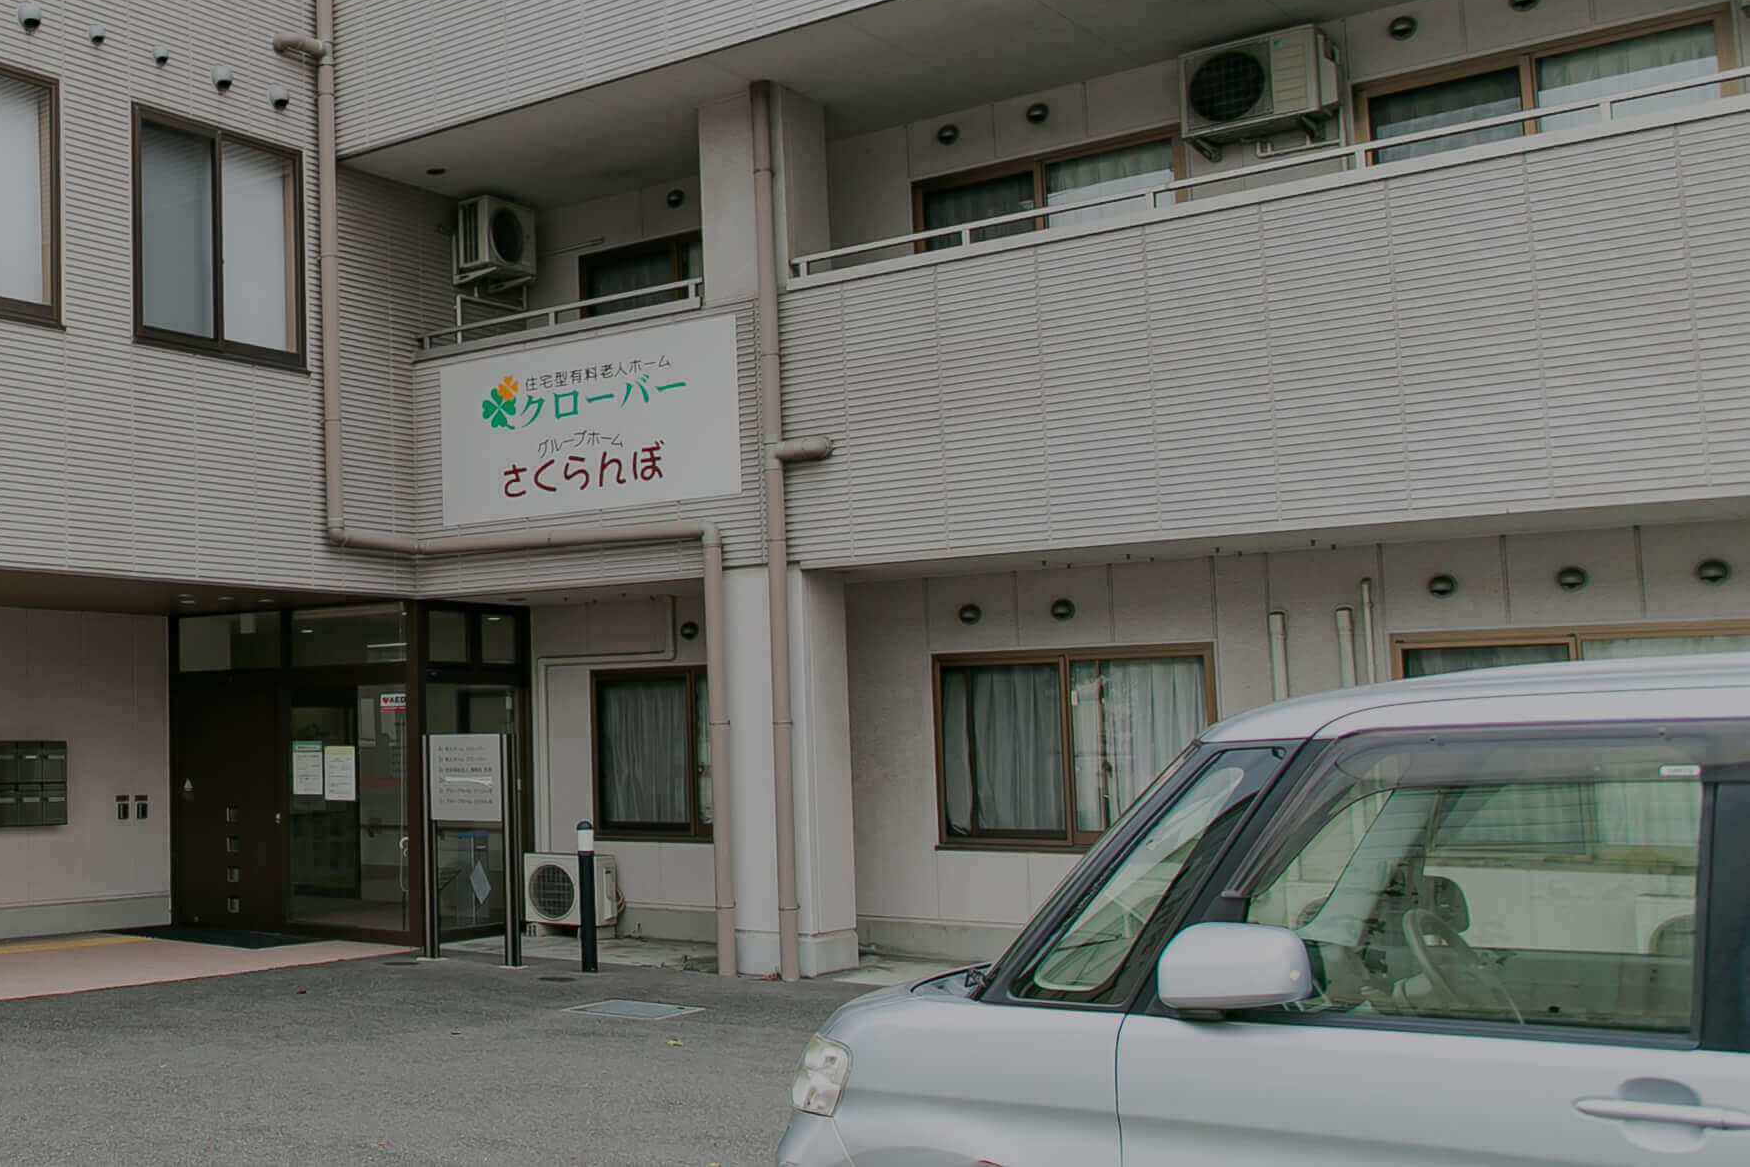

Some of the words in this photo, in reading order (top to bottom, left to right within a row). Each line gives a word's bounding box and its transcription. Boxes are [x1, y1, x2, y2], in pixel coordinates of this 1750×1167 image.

[524, 354, 671, 392] 住宅型有料老人ホーム
[521, 373, 687, 429] クローバー
[537, 430, 624, 459] グループホーム
[503, 439, 666, 498] さくらんぼ
